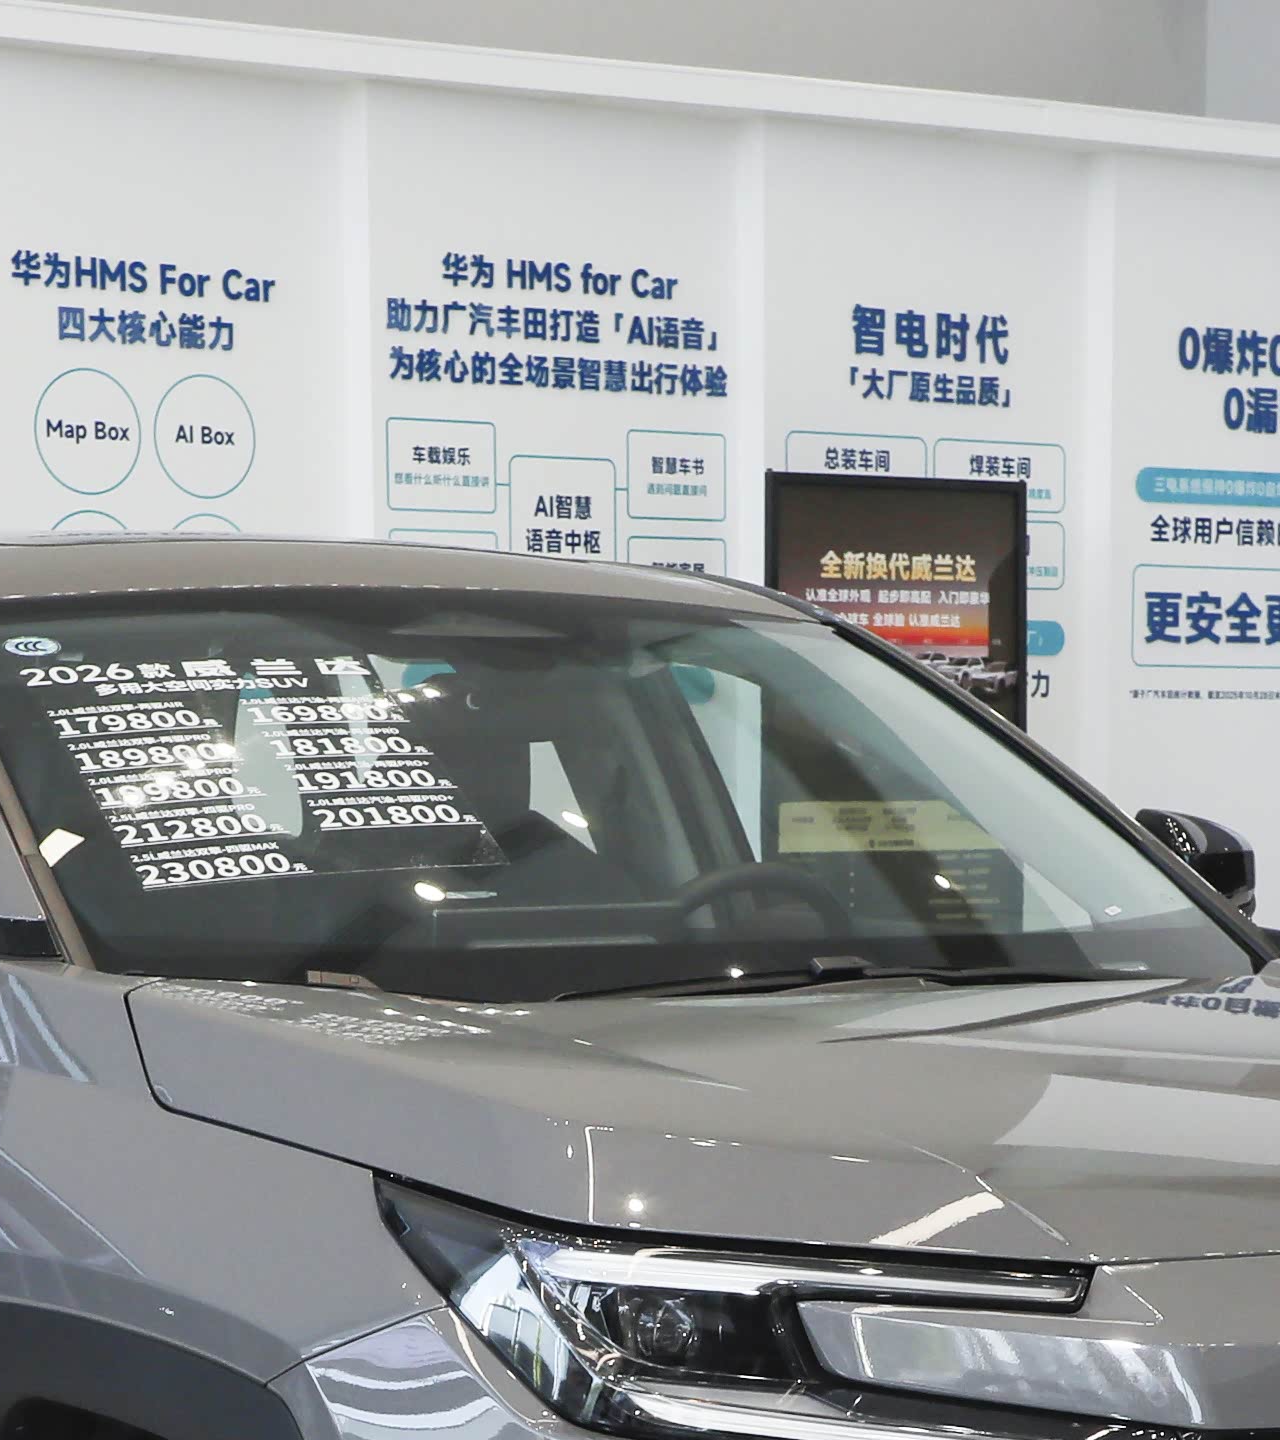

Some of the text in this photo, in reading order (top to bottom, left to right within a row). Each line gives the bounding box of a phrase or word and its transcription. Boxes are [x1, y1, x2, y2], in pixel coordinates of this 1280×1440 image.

[11, 249, 276, 303] 华为HMS For Car
[442, 251, 678, 301] 华为 HMS for Car
[57, 306, 236, 352] 四大核心能力
[851, 303, 1011, 366] 智电时代
[389, 346, 729, 398] 为核心的全场景智慧出行体验
[46, 419, 131, 445] Map Box
[175, 425, 236, 446] AI Box
[412, 445, 471, 466] 车载娱乐
[651, 456, 705, 476] 智慧车书
[824, 446, 891, 472] 总装车间
[969, 454, 1032, 479] 焊装车间
[534, 494, 593, 520] AI智慧
[525, 528, 602, 554] 语音中枢
[820, 550, 977, 583] 全新换代威兰达
[75, 742, 240, 772] 189800
